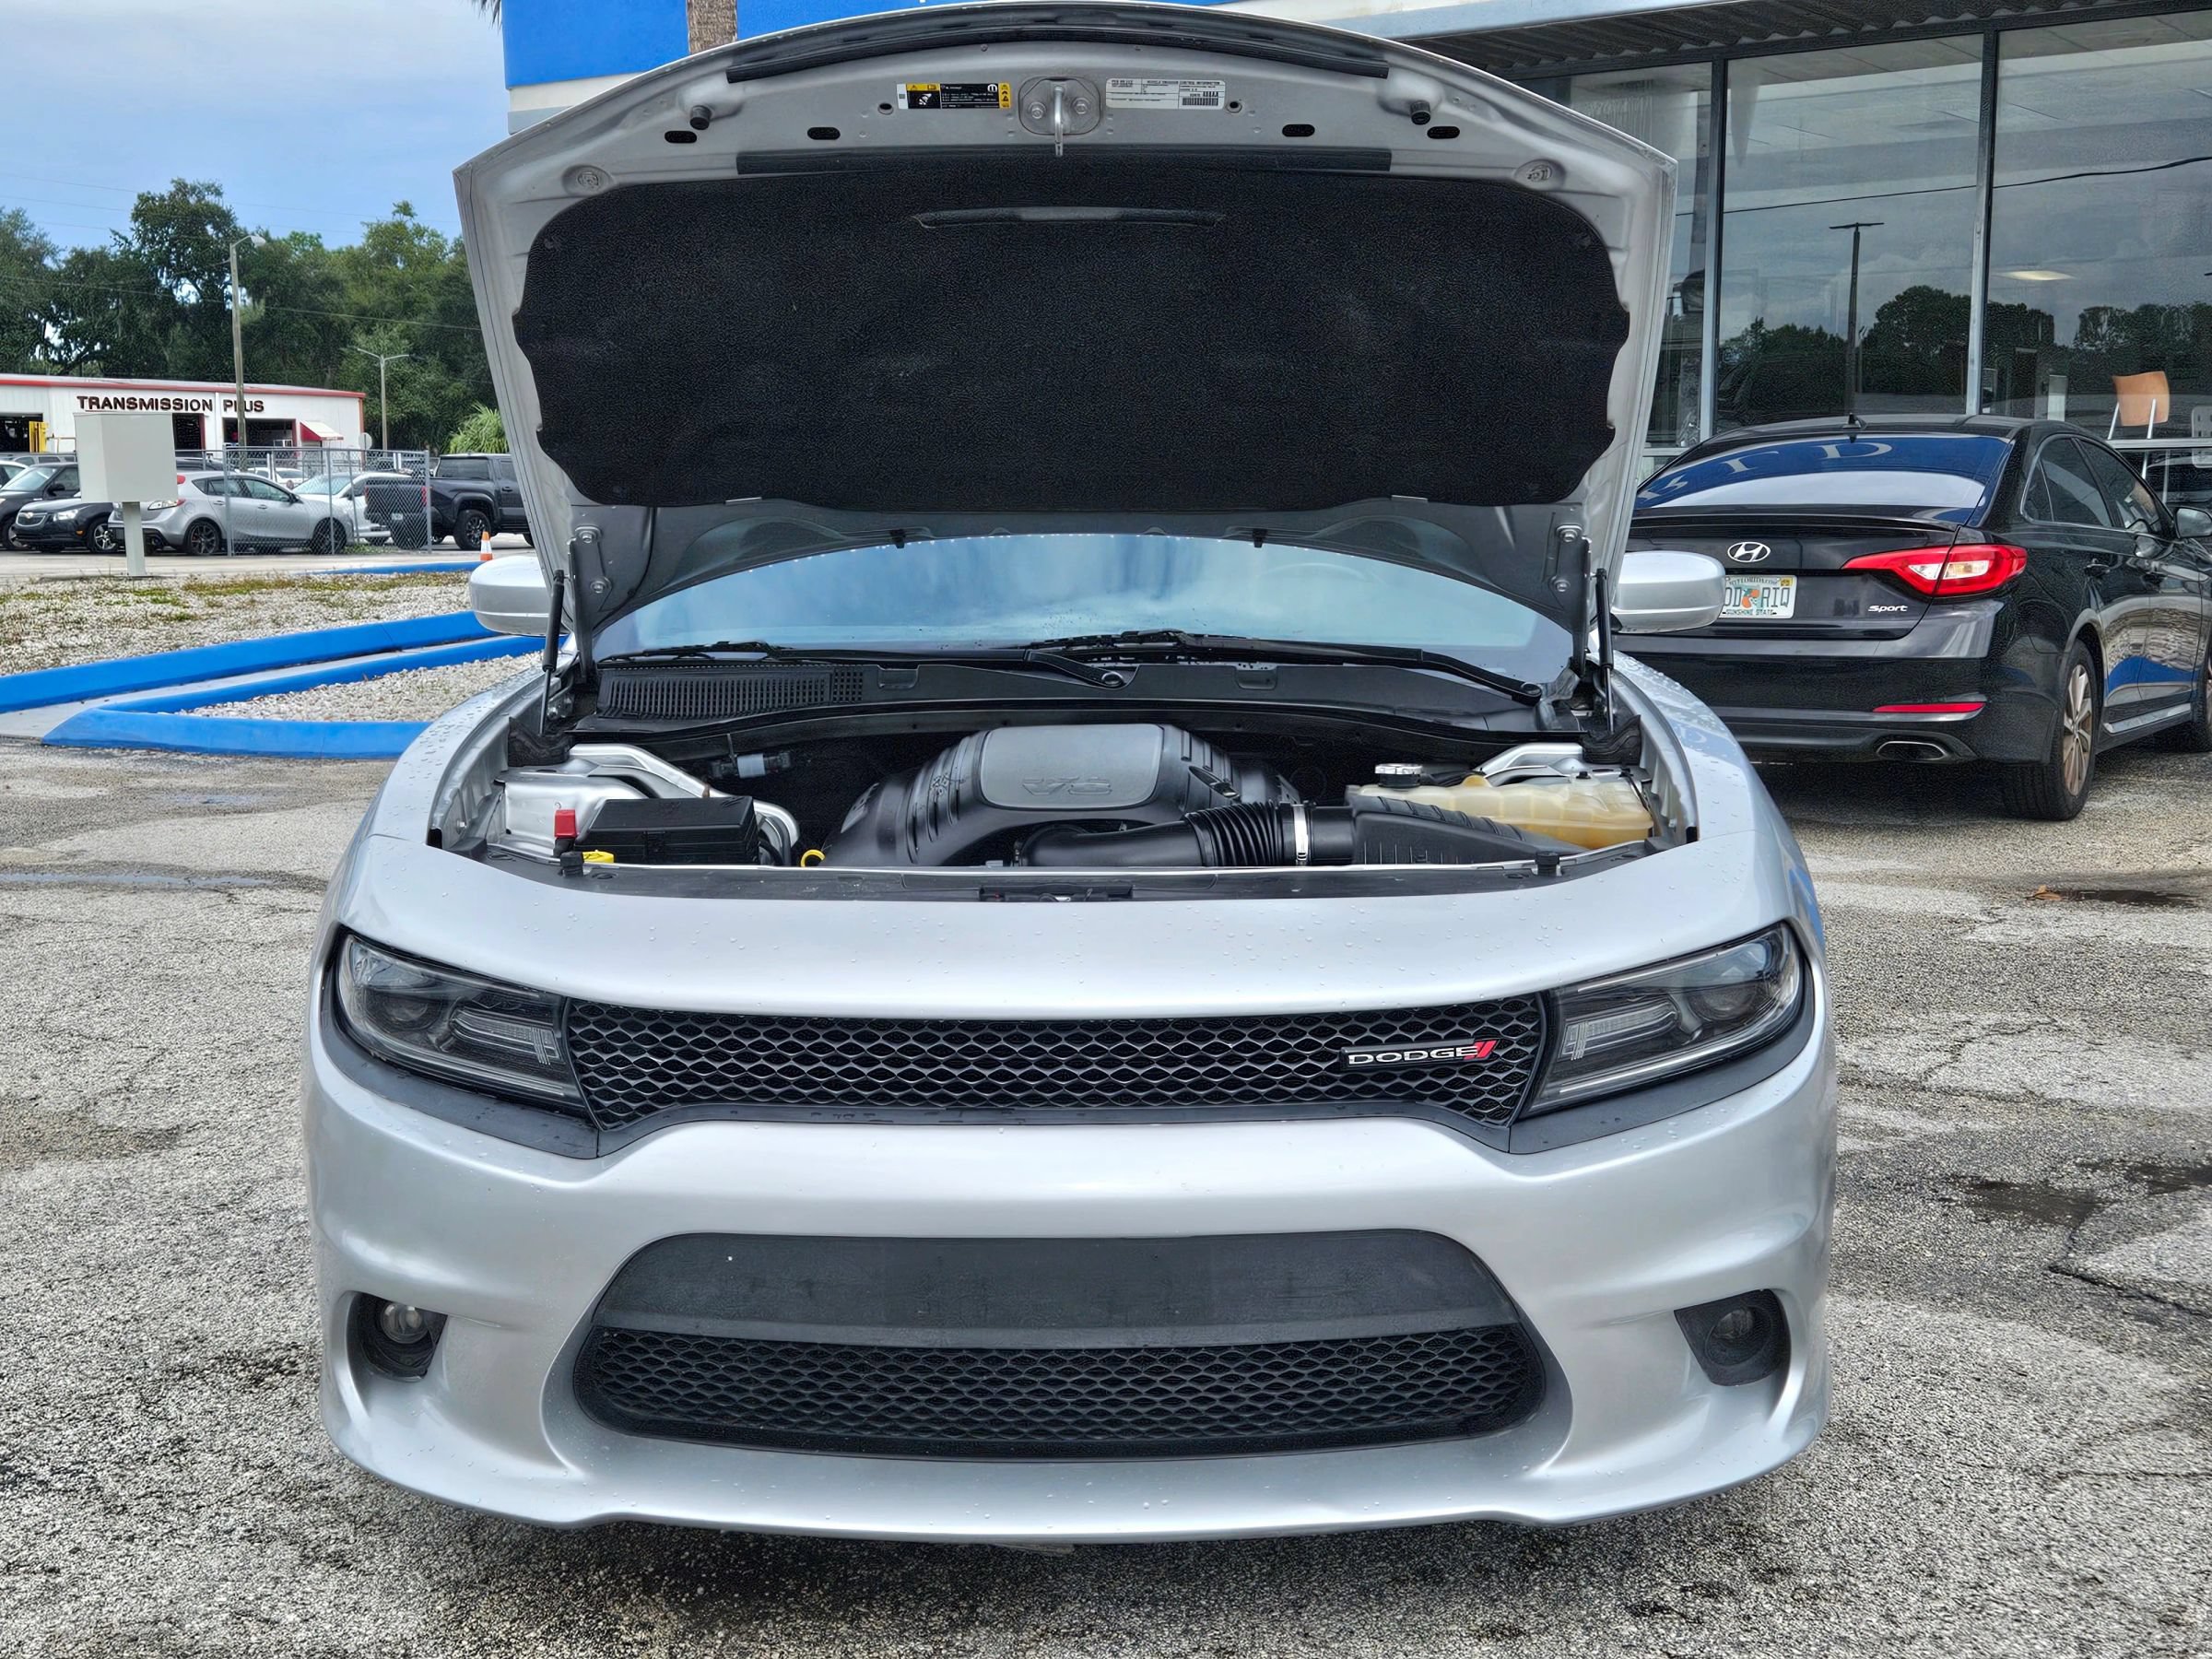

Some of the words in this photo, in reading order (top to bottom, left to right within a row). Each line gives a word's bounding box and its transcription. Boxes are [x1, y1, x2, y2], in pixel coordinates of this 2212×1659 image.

[76, 395, 213, 412] TRANSMISSION
[1867, 605, 1908, 613] Sport
[1347, 1046, 1478, 1065] DODGE
